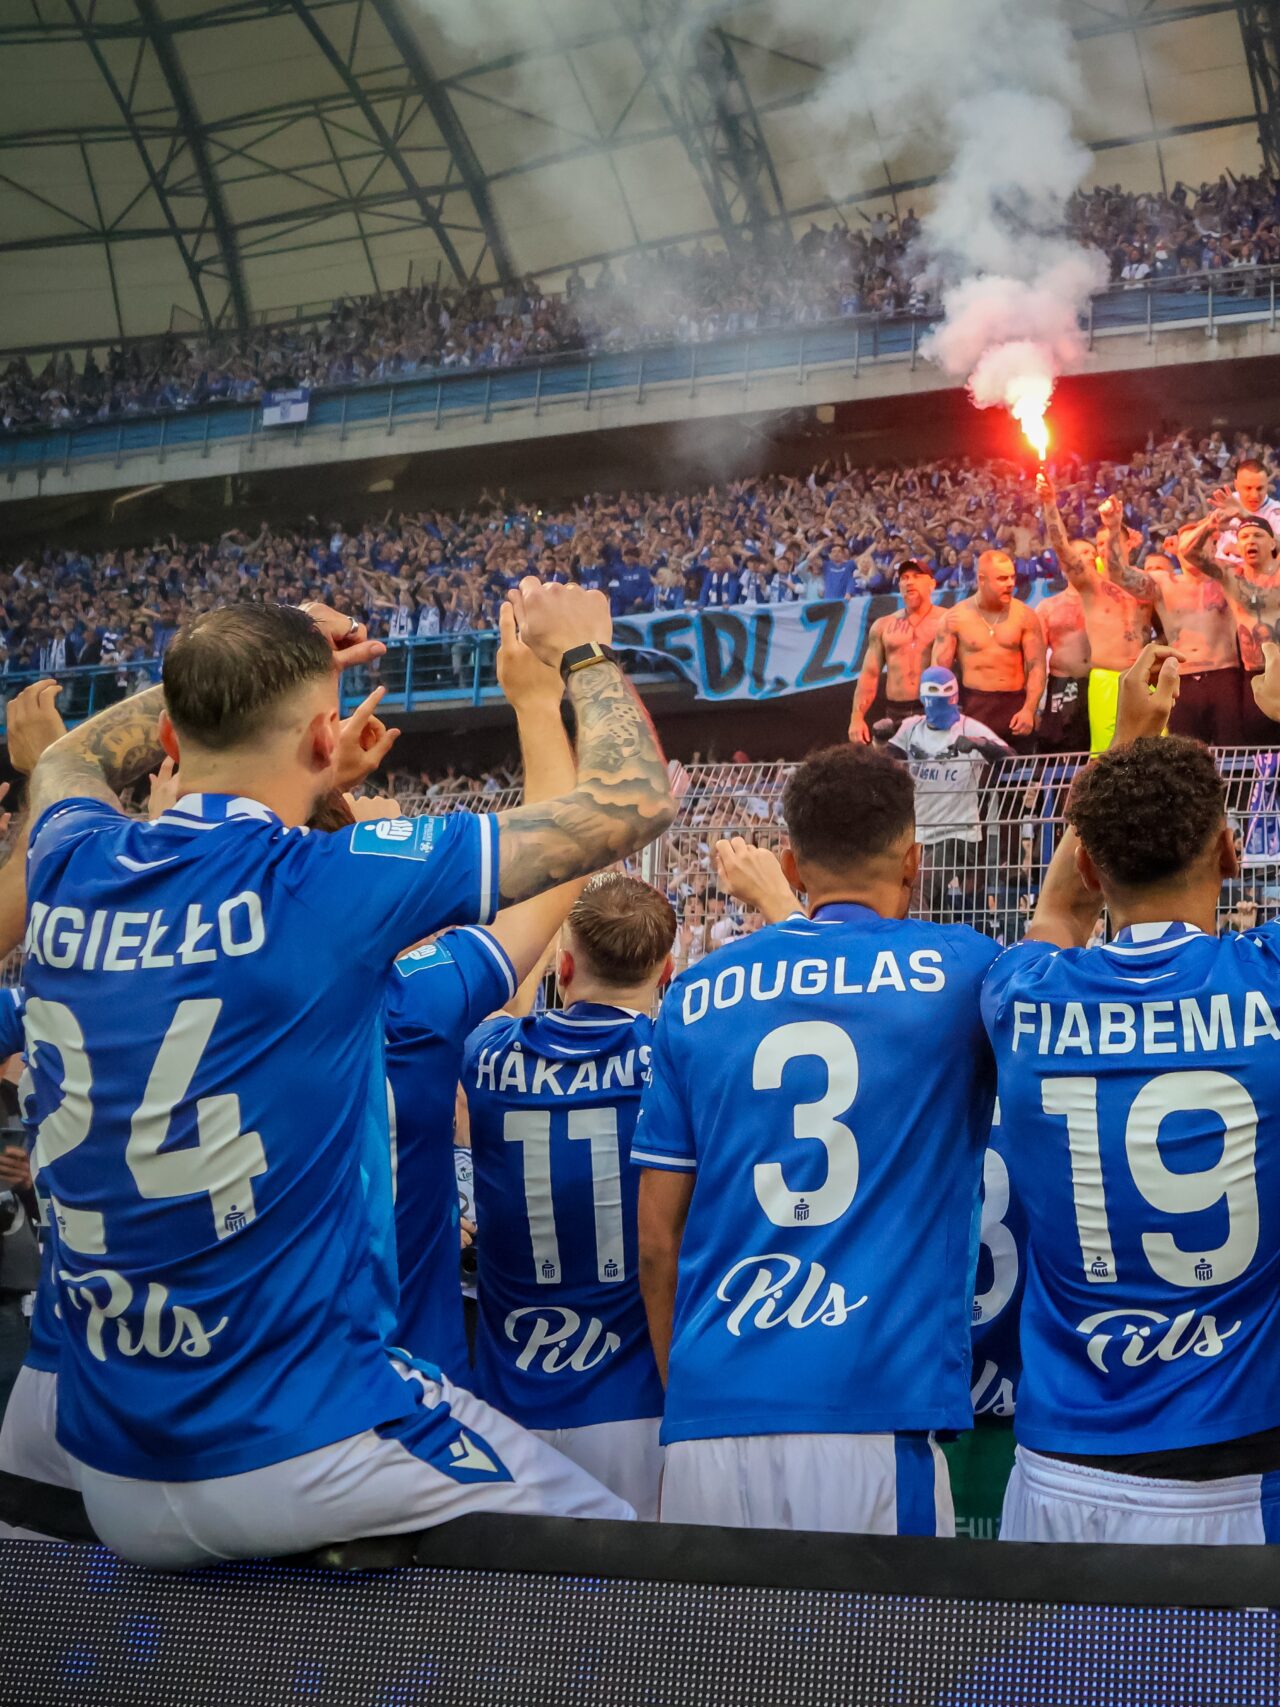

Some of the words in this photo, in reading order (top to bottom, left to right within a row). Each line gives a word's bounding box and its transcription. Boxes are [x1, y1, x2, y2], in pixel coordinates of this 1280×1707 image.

[682, 949, 946, 1027] DOUGLAS
[18, 996, 268, 1256] 24
[503, 1107, 625, 1285] 11
[752, 1020, 860, 1228] 3
[1040, 1070, 1260, 1288] 19
[59, 1268, 229, 1362] Pils
[716, 1253, 868, 1337] Pils
